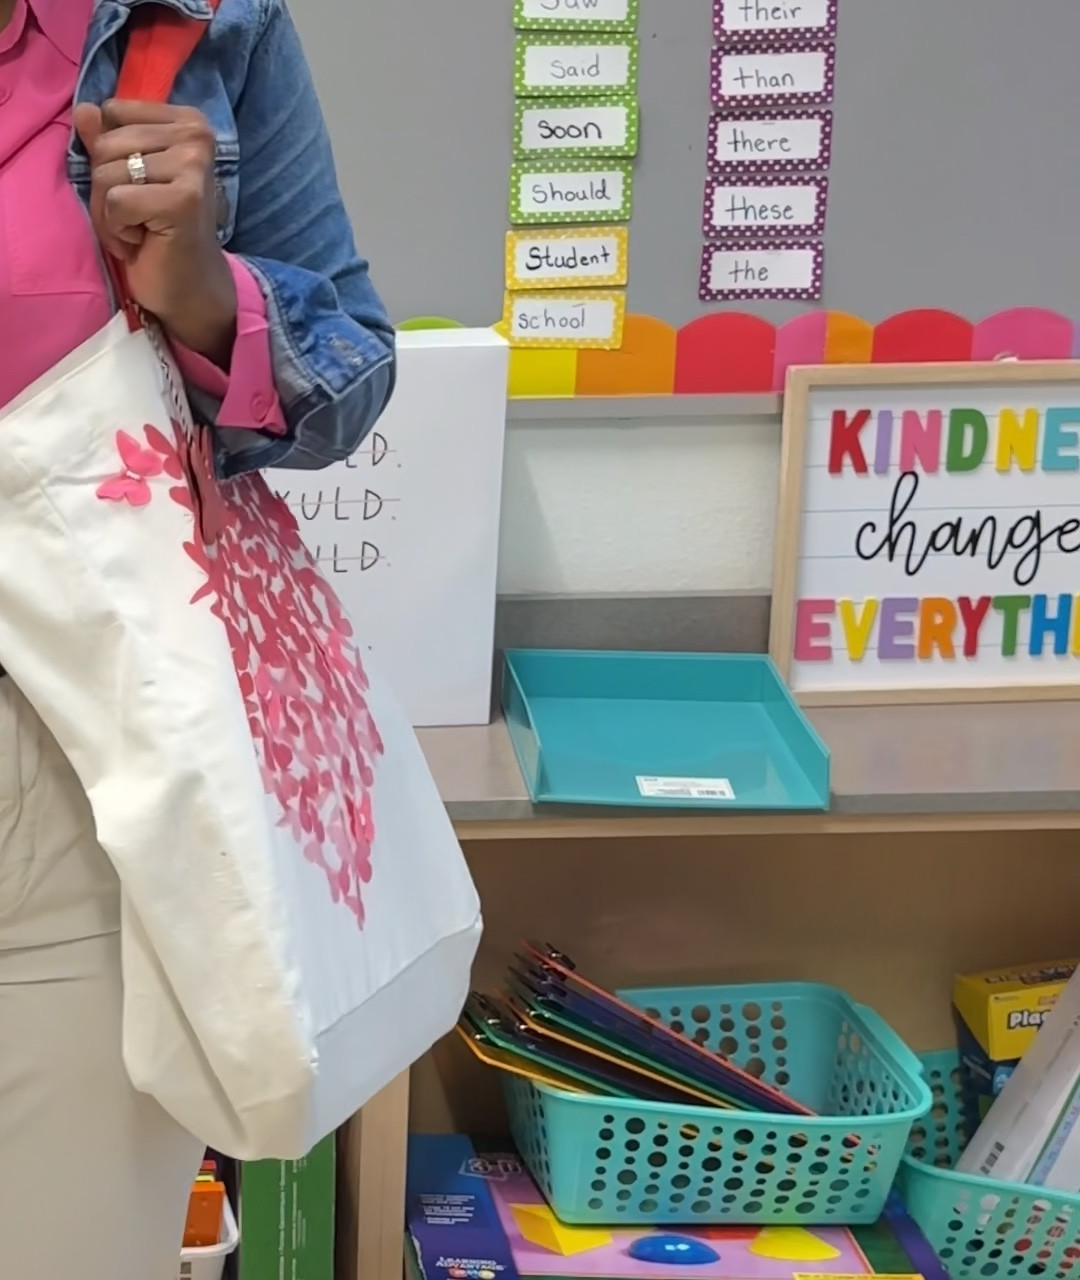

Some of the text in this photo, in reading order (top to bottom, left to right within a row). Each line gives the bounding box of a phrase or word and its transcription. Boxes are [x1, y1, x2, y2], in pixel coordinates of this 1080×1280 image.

[738, 0, 802, 22] their
[732, 66, 795, 90] than
[727, 130, 791, 153] there
[724, 196, 794, 221] these
[525, 245, 610, 272] Student
[728, 259, 769, 284] the
[518, 308, 586, 330] school
[855, 470, 1080, 586] change
